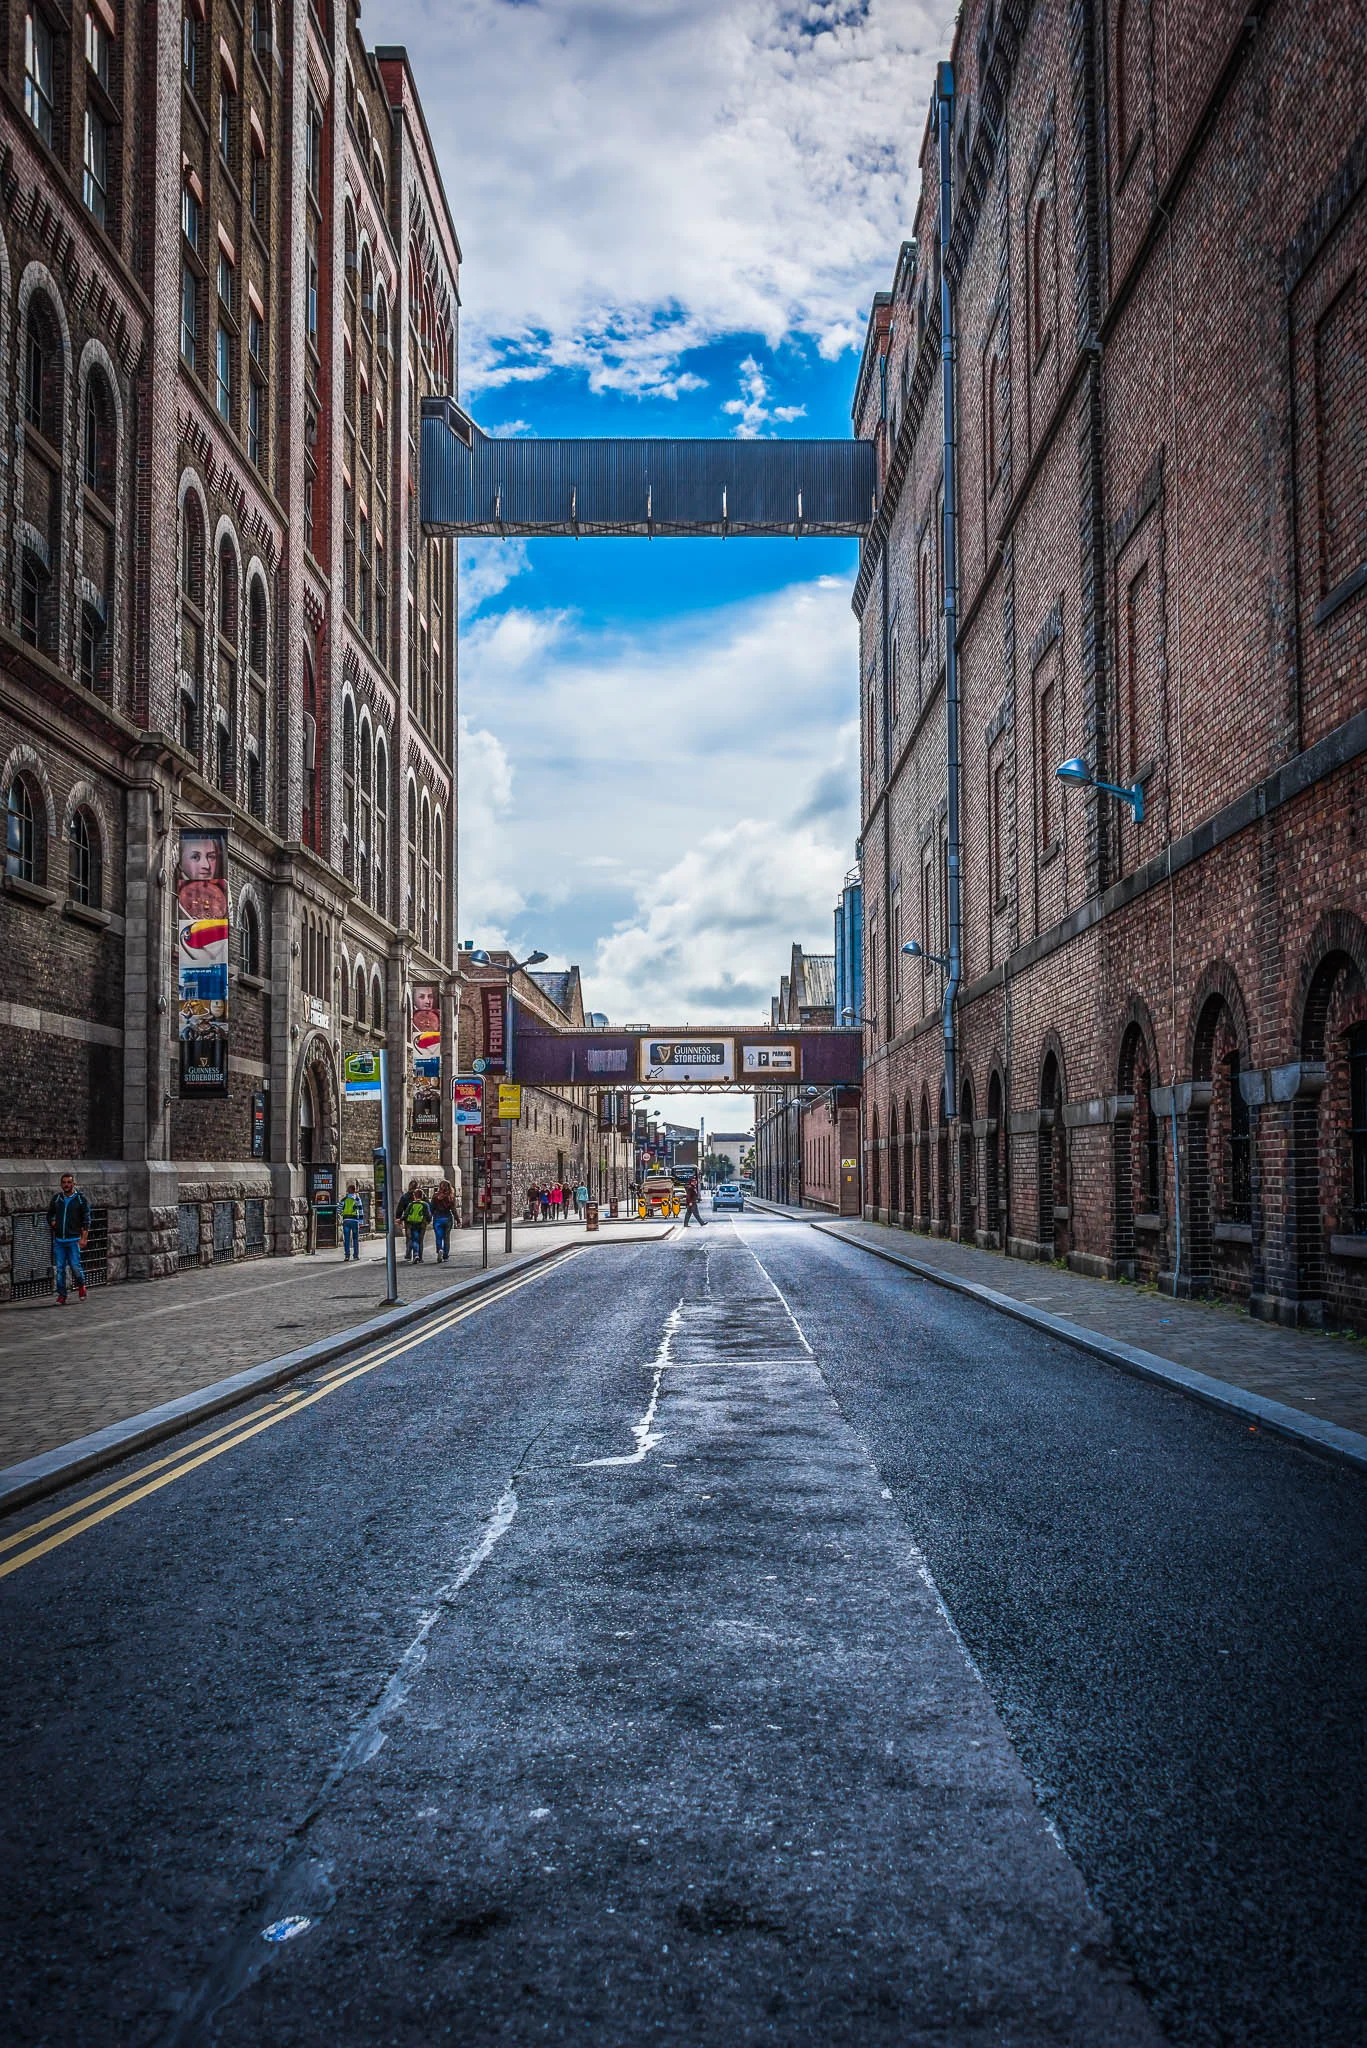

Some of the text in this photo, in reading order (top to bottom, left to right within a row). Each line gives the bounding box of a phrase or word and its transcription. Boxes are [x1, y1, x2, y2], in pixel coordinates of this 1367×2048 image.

[488, 994, 502, 1052] FERMENT
[674, 1045, 711, 1055] GUINNESS
[674, 1054, 721, 1063] STOREHOUSE
[760, 1053, 767, 1065] P
[188, 1066, 220, 1075] GUINNESS
[184, 1073, 224, 1082] STOREHOUSE
